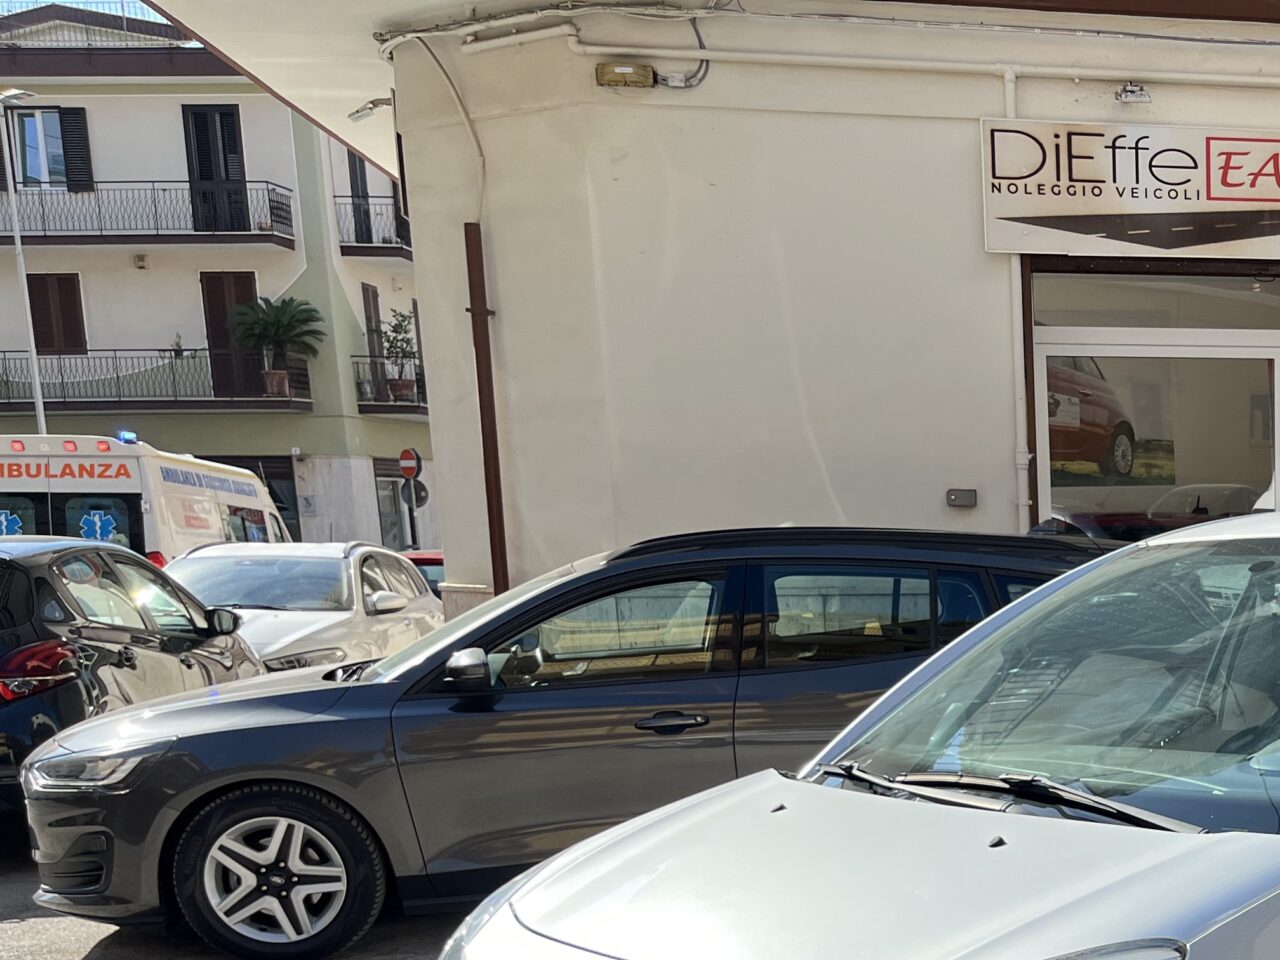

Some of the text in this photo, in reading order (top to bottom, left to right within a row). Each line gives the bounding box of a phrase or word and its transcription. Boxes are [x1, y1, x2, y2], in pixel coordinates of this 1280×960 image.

[990, 128, 1199, 186] DiEffe
[991, 182, 1200, 201] NOLEGGIO VEICOLI
